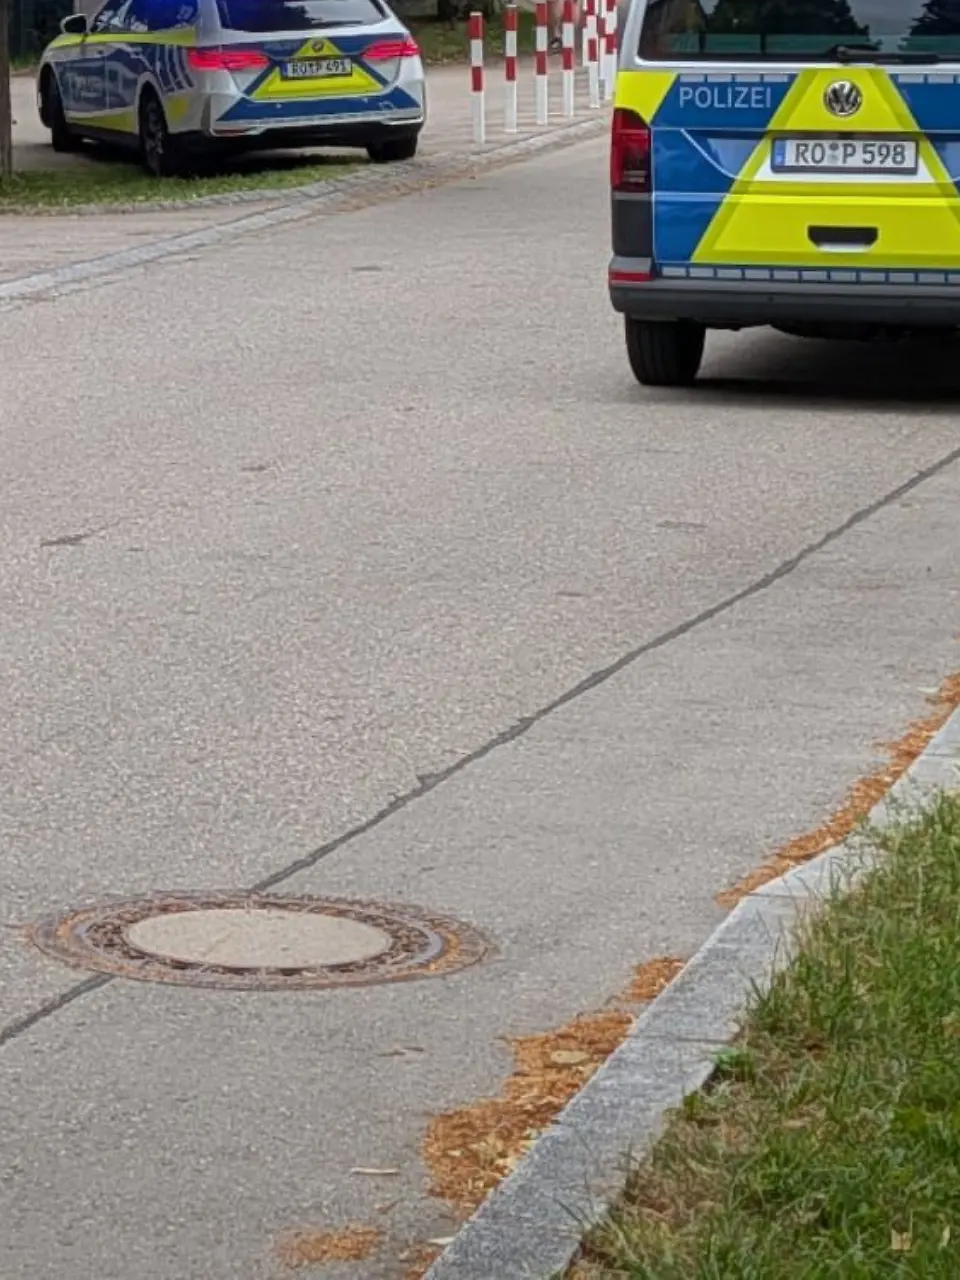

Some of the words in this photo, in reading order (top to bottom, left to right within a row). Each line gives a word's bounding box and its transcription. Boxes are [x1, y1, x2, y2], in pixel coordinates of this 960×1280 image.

[679, 86, 771, 109] POLIZEI
[795, 142, 826, 165] RO
[842, 143, 857, 165] P
[862, 143, 906, 165] 598
